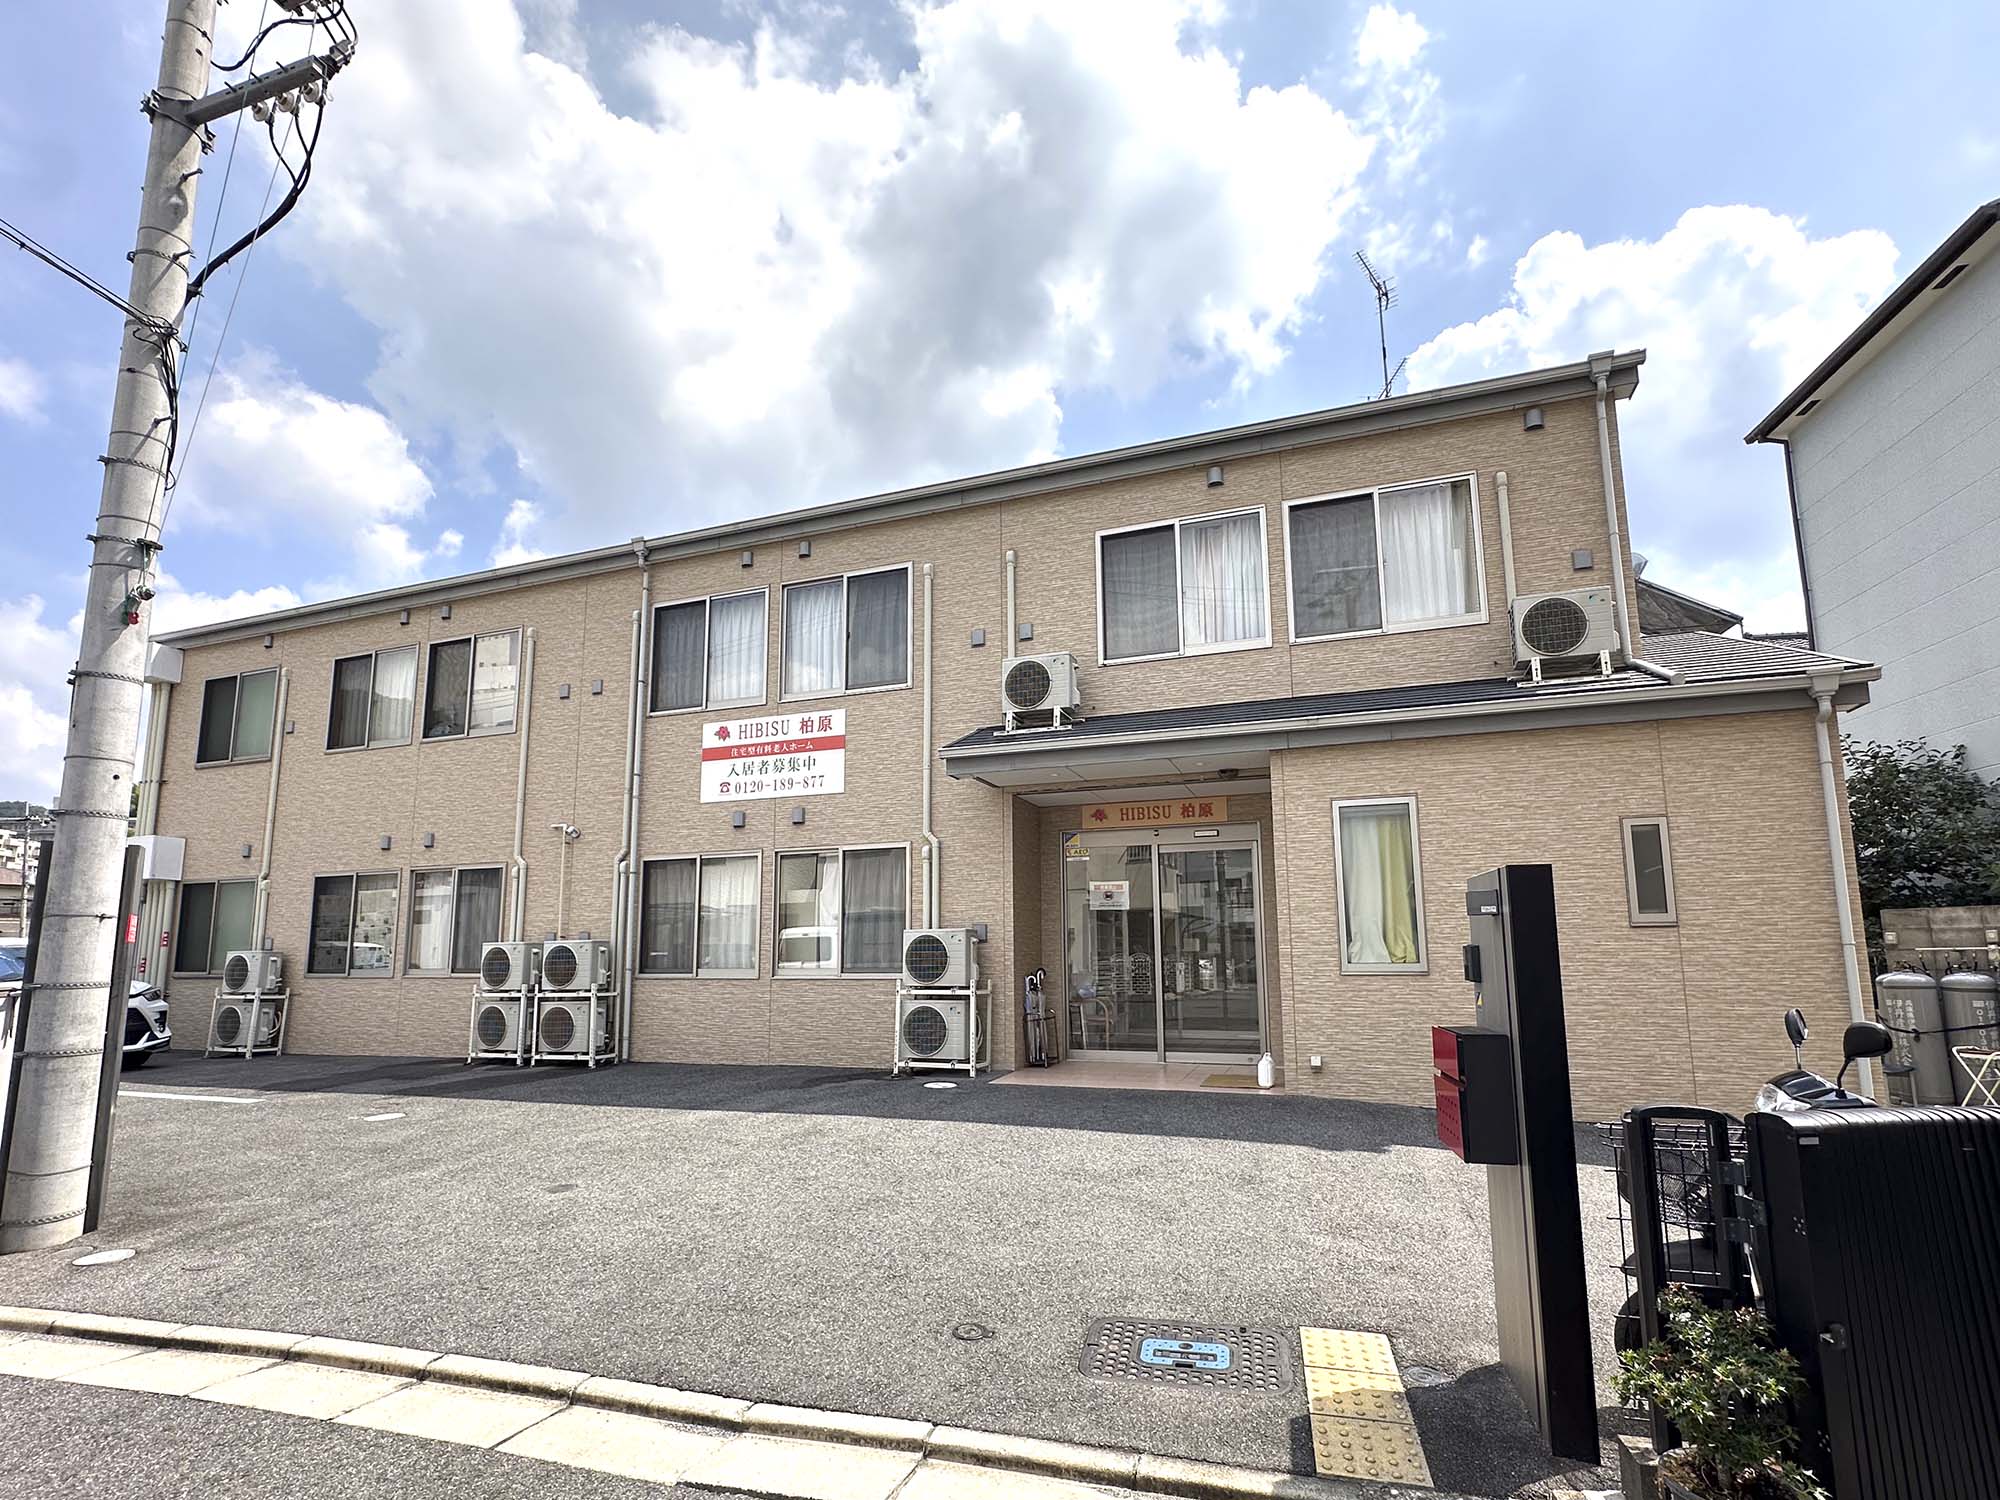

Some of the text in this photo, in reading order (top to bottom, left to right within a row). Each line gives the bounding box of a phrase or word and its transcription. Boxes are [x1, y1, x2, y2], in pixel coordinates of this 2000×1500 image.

[738, 714, 833, 740] HIBISU 柏原
[730, 742, 815, 757] 住宅型有料老人ホーム
[727, 755, 816, 778] 入居者募集中
[734, 775, 825, 794] 0120-189-877
[1119, 802, 1214, 821] HIBISU 柏原
